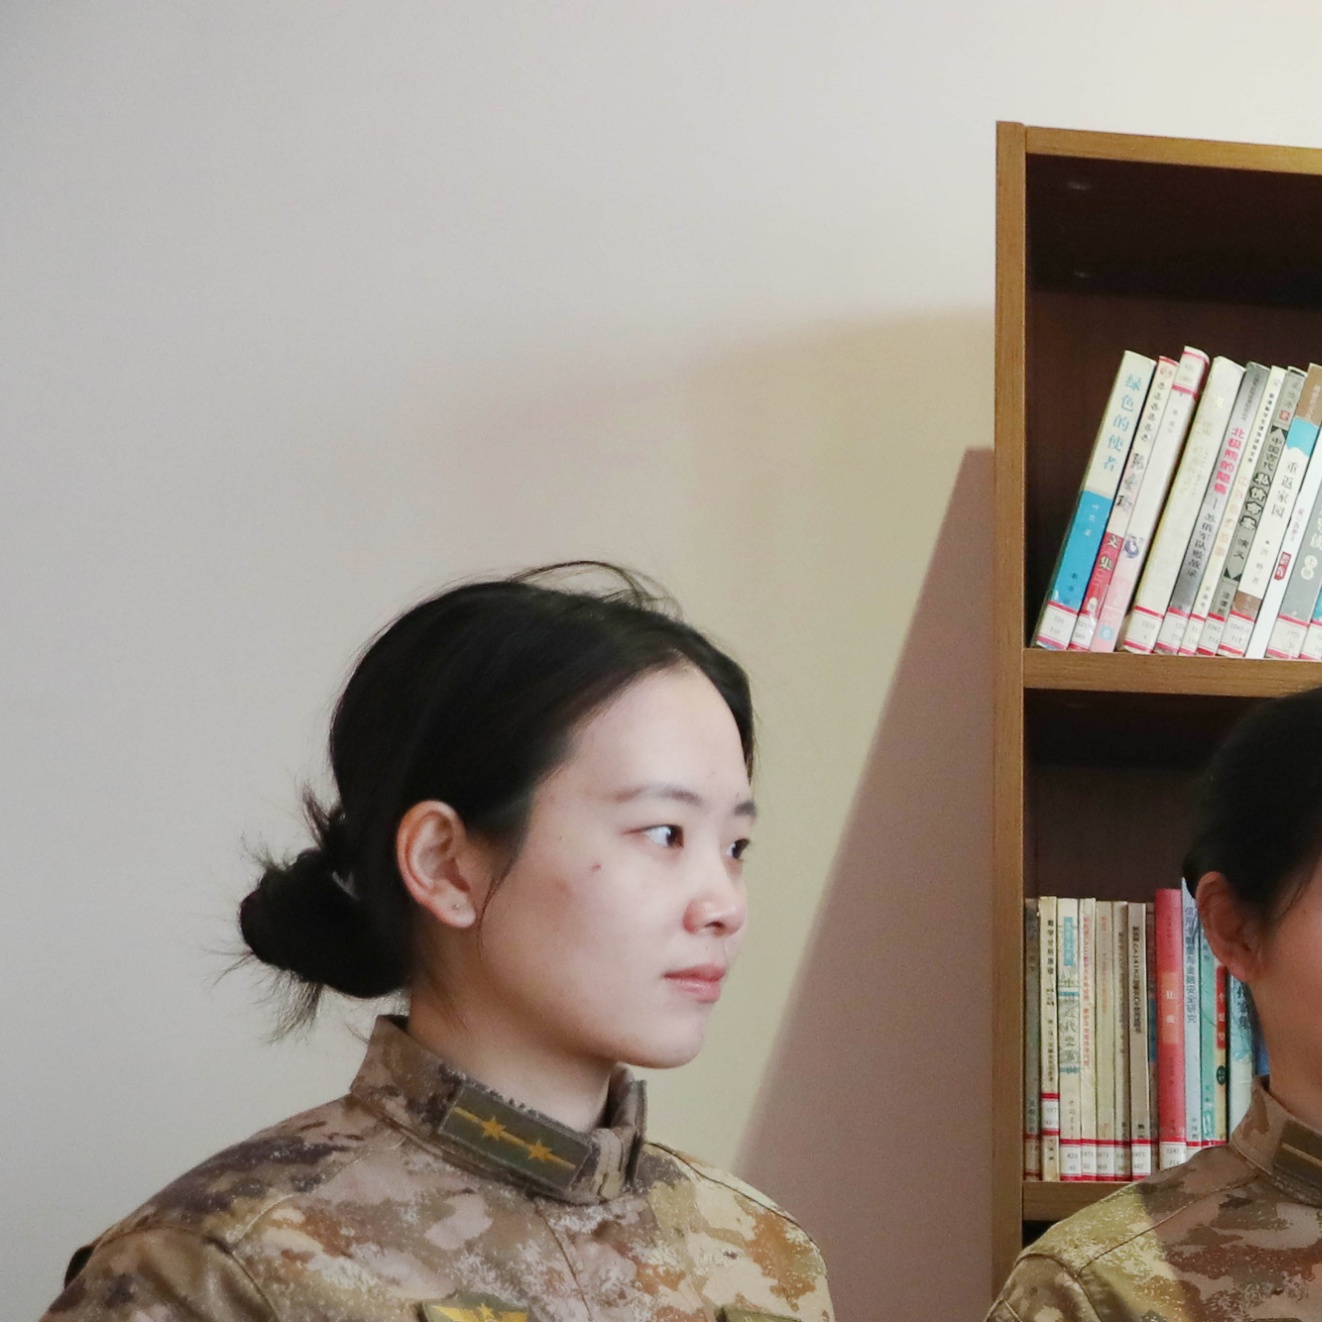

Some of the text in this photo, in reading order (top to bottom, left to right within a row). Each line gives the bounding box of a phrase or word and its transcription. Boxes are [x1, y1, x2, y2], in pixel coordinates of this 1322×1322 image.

[1102, 374, 1142, 471] 绿色的使者
[1271, 461, 1298, 518] 重返家园
